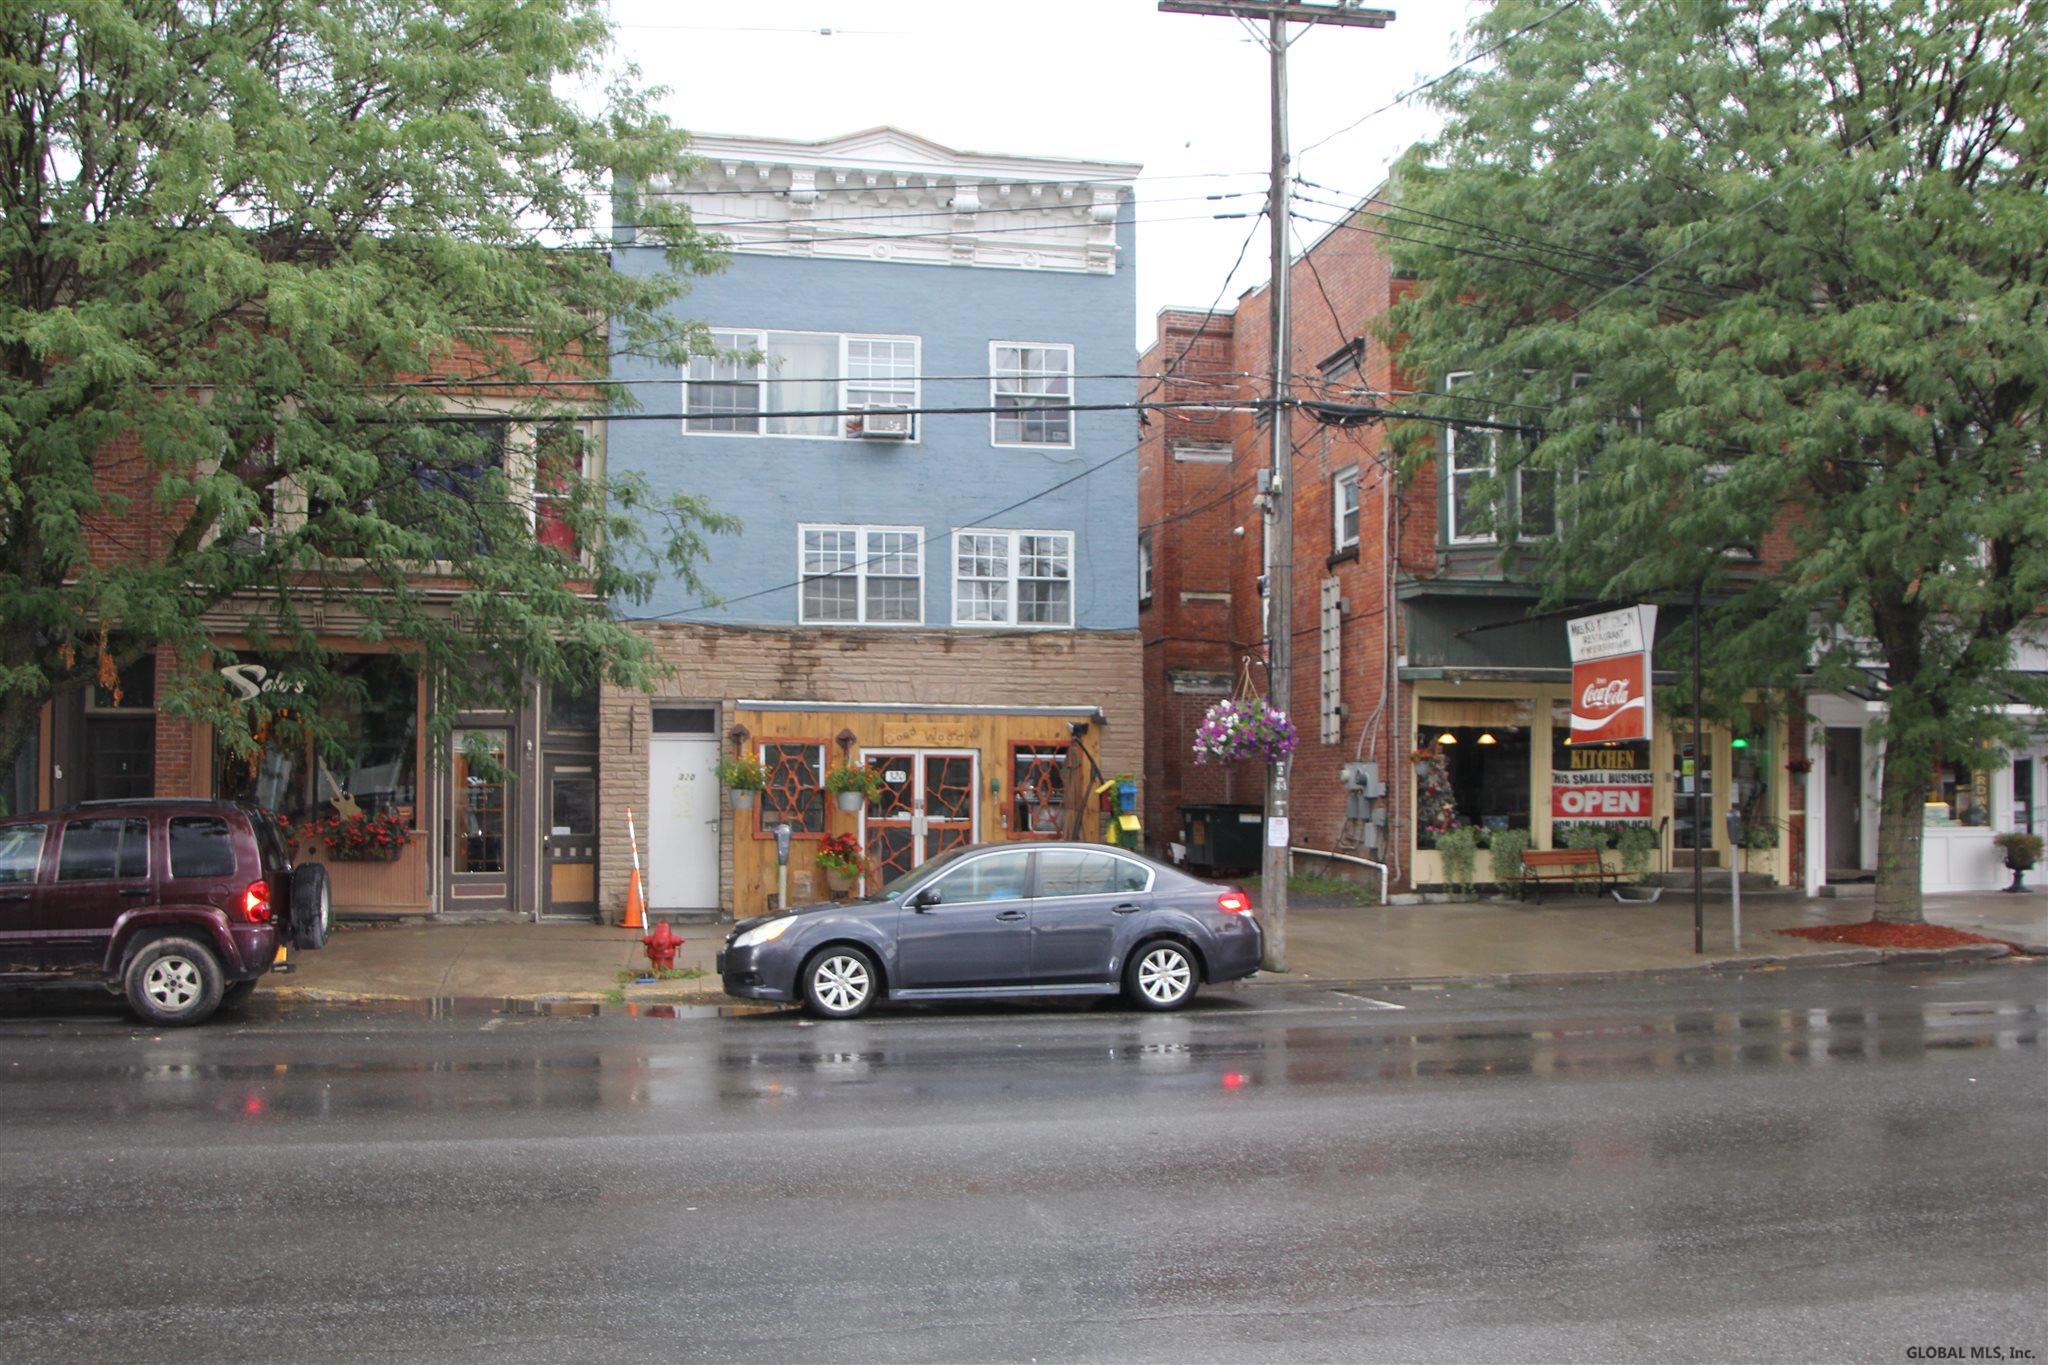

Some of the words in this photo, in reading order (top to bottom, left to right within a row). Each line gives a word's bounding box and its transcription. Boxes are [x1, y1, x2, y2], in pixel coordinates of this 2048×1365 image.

[1570, 749, 1635, 769] KITCHEN
[1573, 774, 1605, 785] SMALL
[1561, 790, 1640, 814] OPEN
